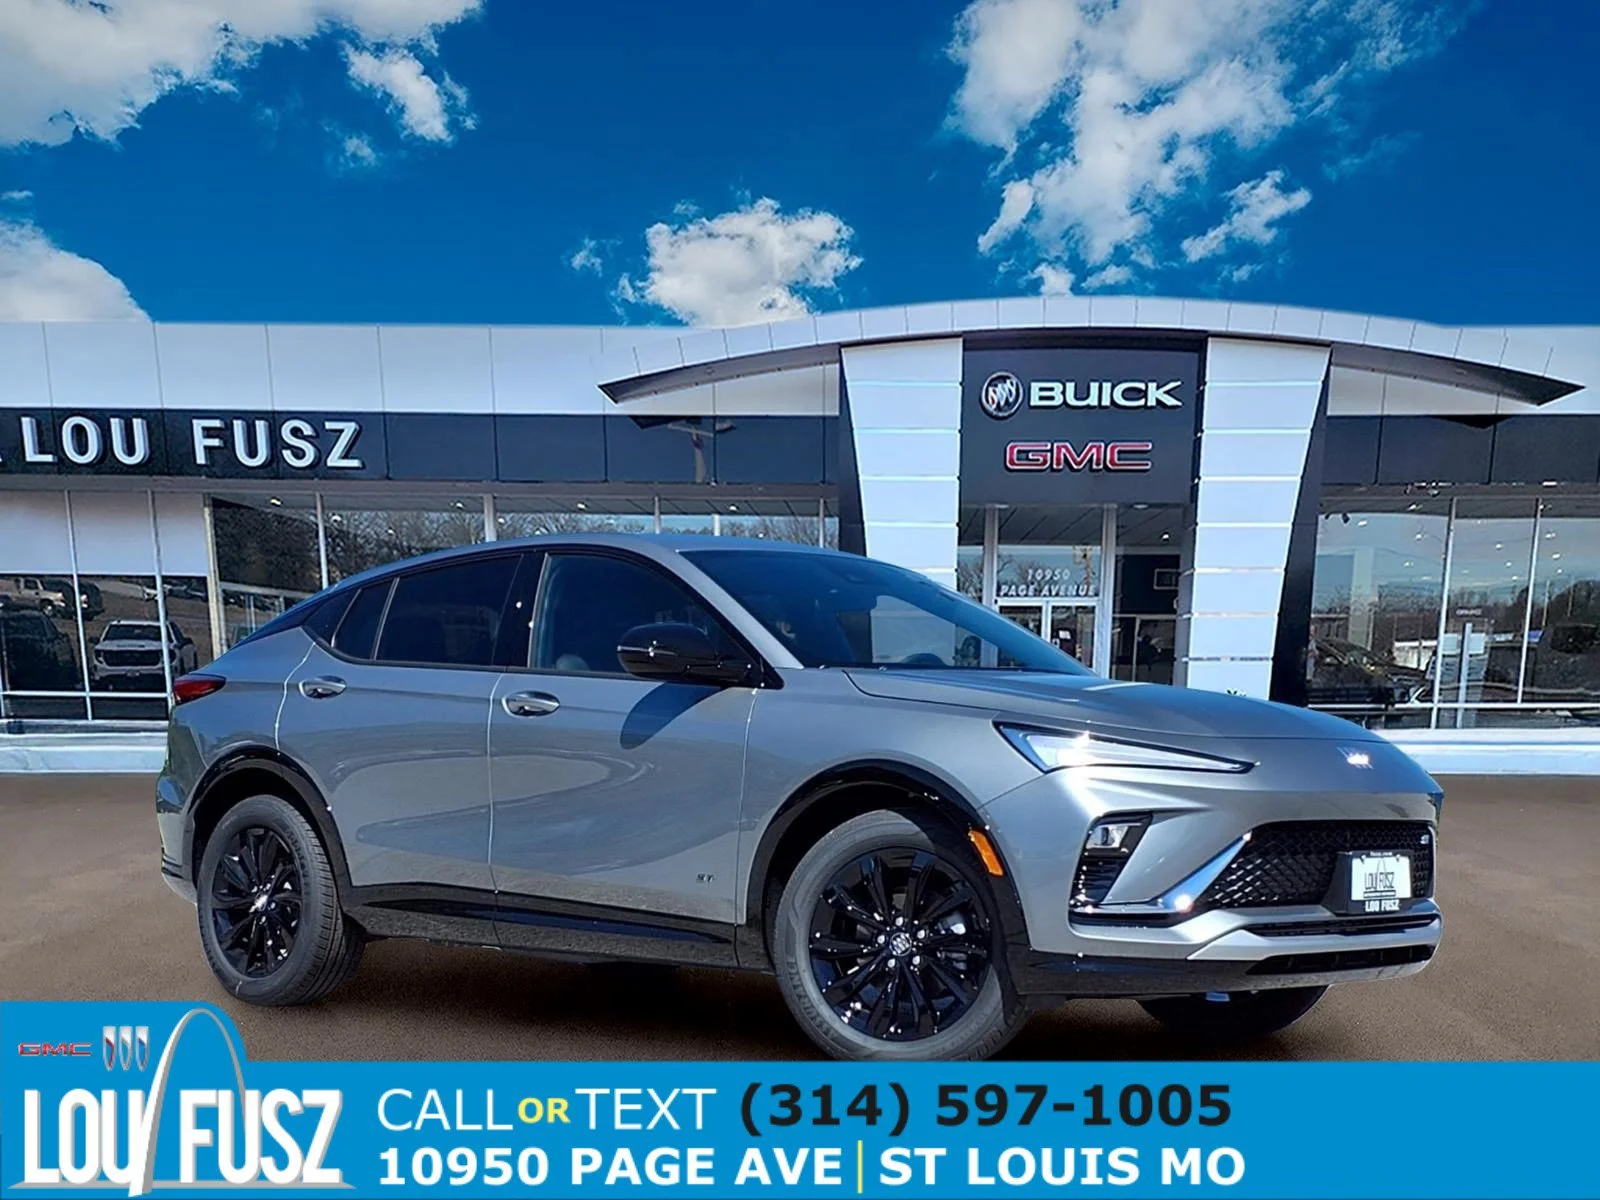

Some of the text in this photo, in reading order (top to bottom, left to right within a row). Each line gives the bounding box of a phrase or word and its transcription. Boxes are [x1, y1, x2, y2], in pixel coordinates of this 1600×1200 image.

[1030, 381, 1183, 407] BUICK
[20, 416, 363, 468] LOU FUSZ
[1006, 441, 1153, 470] GMC
[1027, 568, 1071, 581] 10950
[1000, 584, 1096, 596] PAGE AVENUE
[1365, 899, 1400, 912] LOU FUSZ
